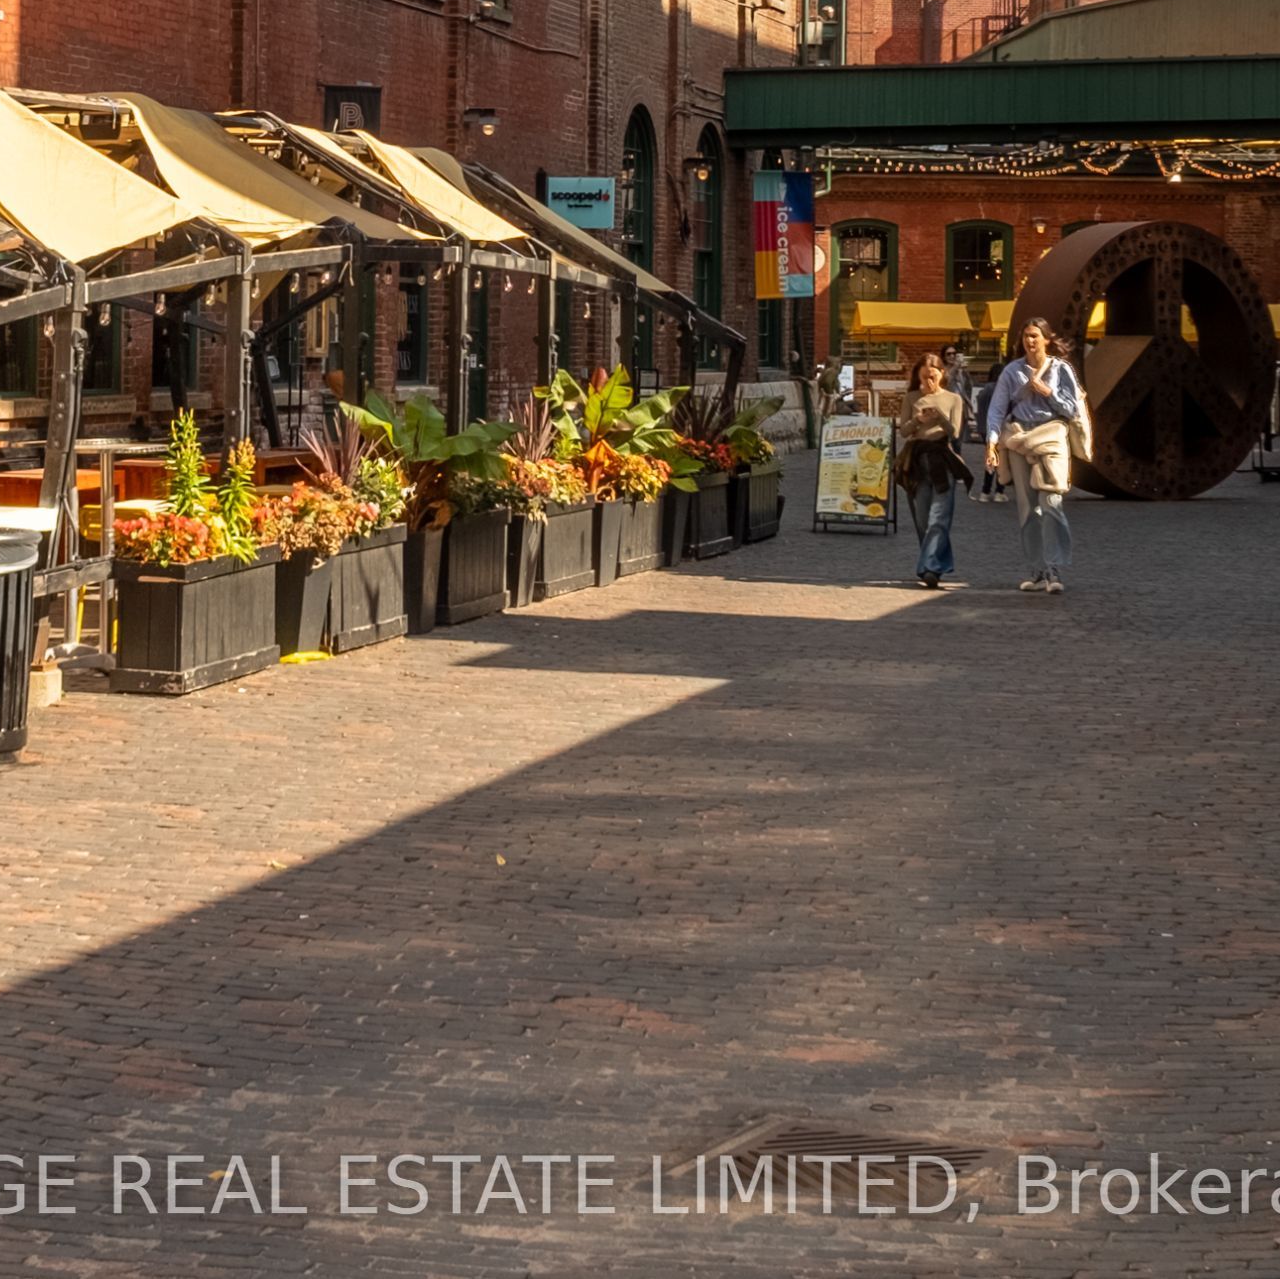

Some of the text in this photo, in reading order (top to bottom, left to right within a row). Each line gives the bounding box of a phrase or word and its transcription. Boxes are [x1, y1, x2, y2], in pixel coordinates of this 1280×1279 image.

[551, 189, 602, 203] scooped
[777, 207, 793, 292] ice cream
[825, 426, 885, 442] LEMONADE
